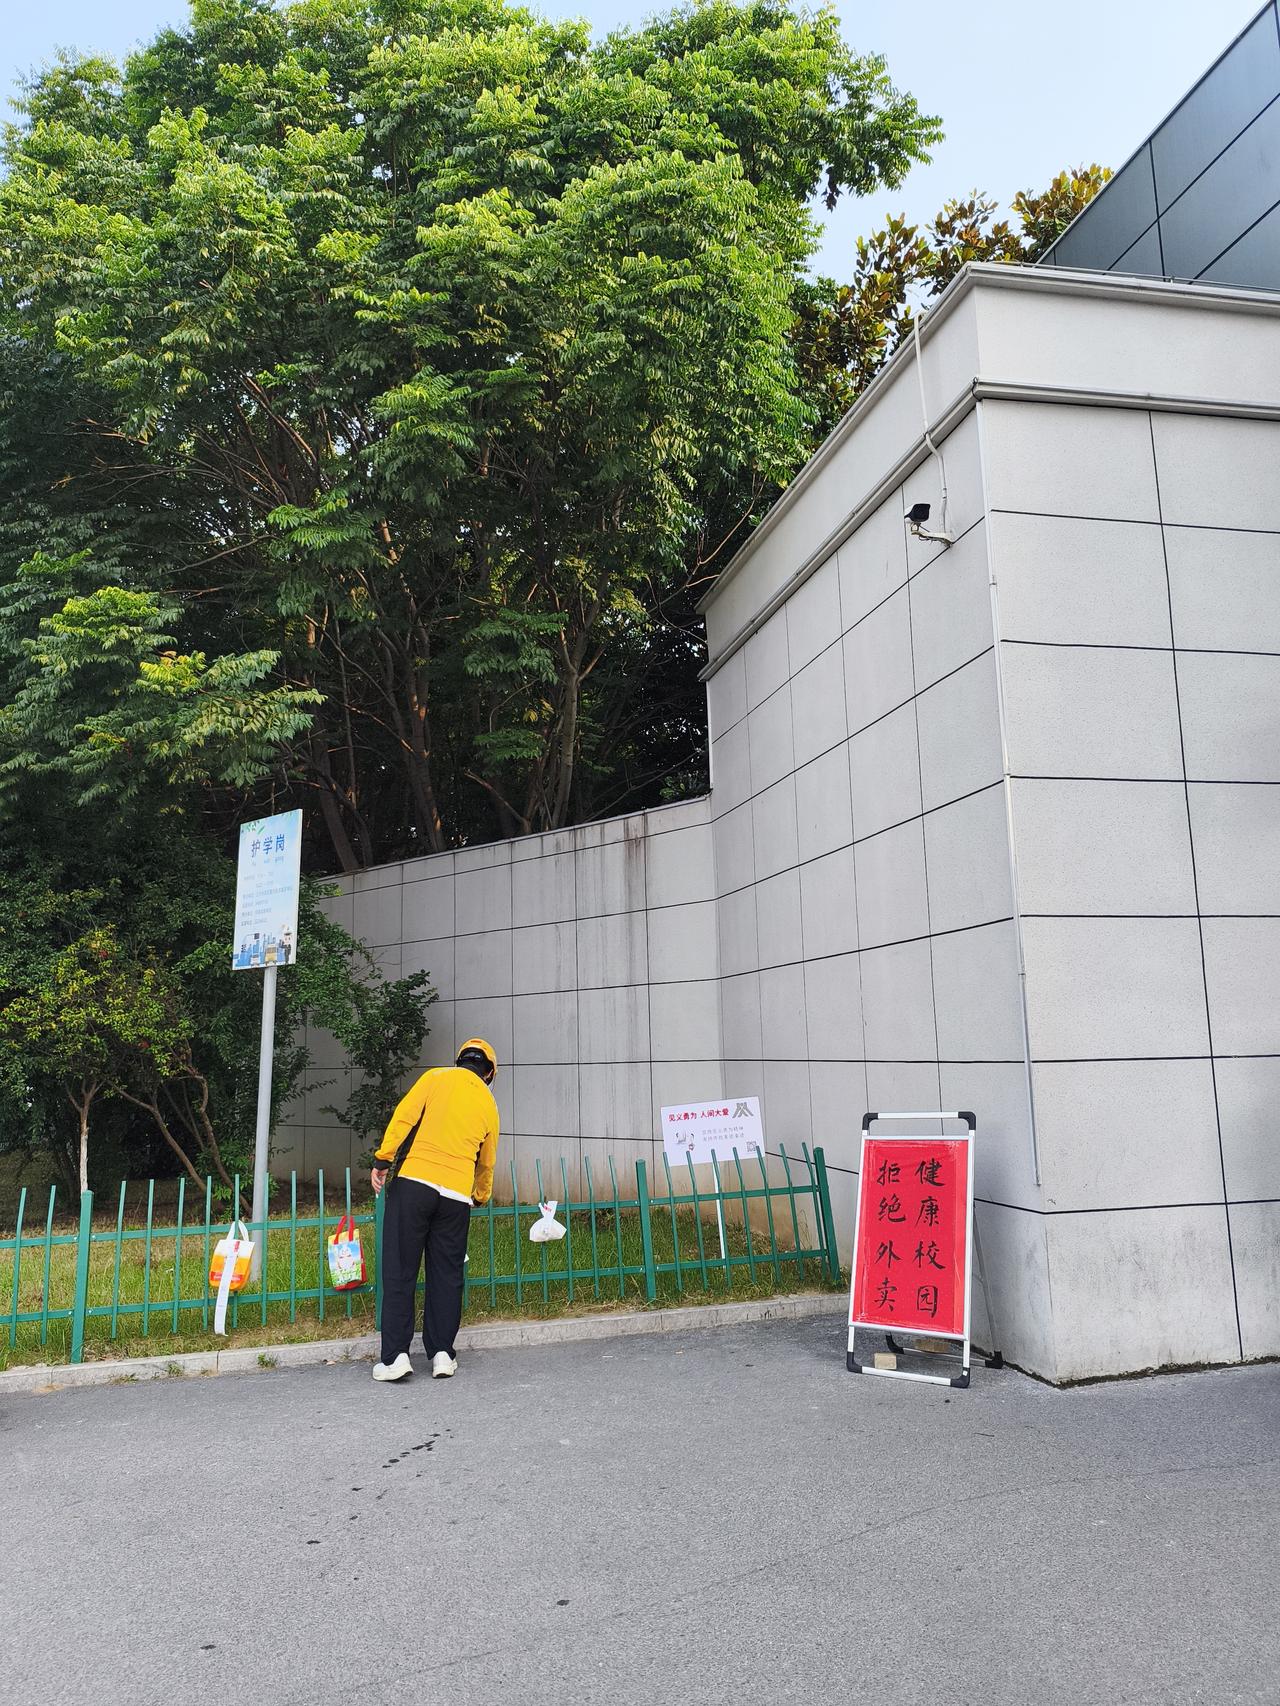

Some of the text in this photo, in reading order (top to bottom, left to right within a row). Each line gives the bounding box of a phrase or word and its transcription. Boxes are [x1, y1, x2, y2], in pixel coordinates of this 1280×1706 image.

[251, 833, 285, 858] 护学岗
[874, 1159, 906, 1312] 拒绝外卖
[912, 1158, 946, 1318] 健康校园
